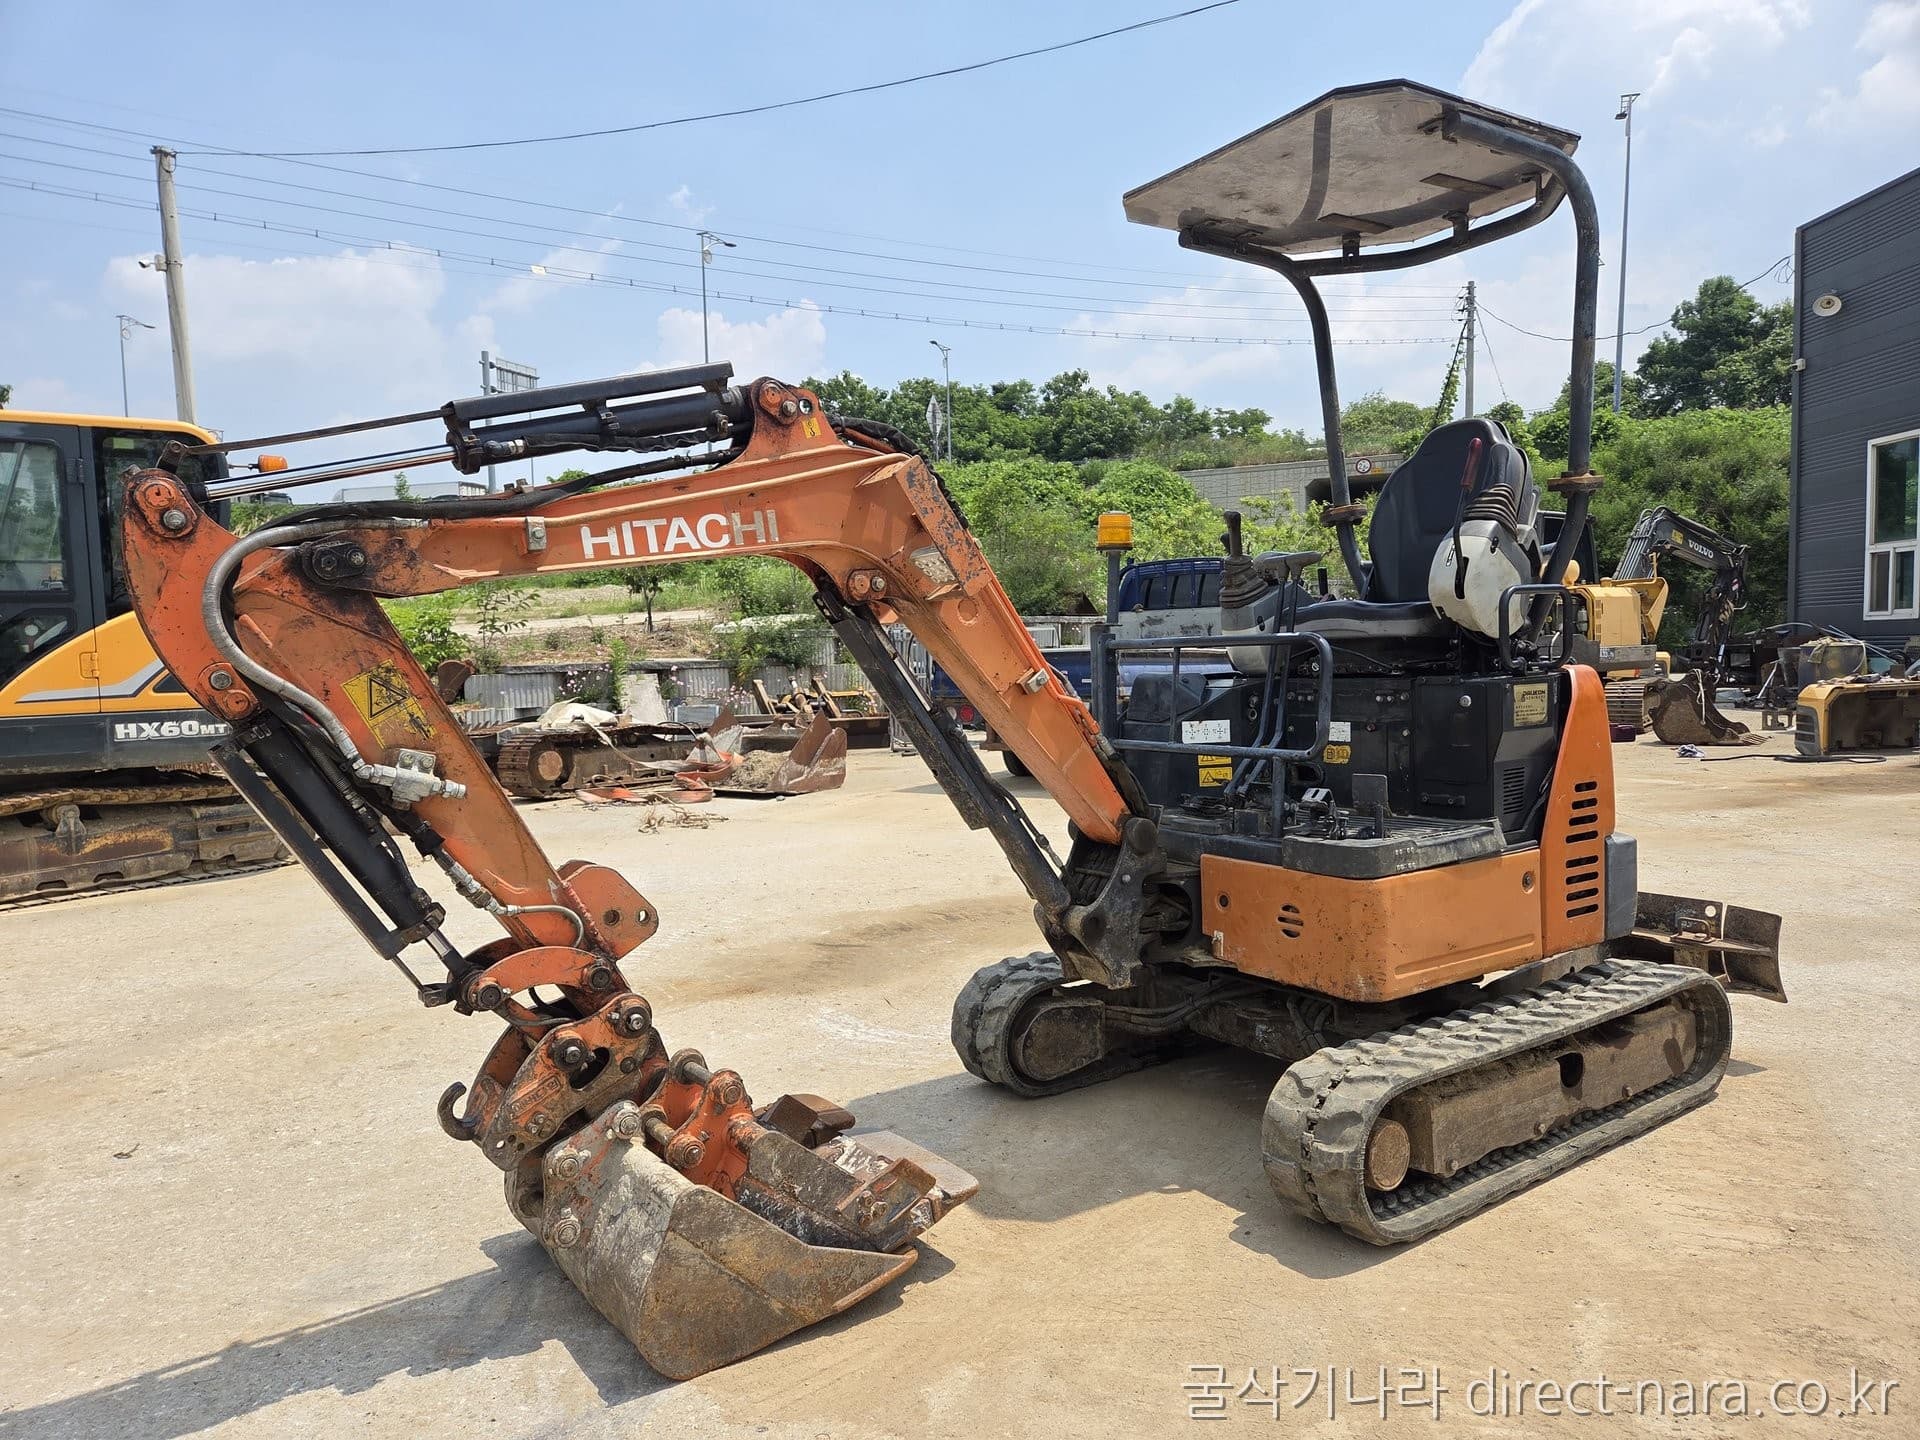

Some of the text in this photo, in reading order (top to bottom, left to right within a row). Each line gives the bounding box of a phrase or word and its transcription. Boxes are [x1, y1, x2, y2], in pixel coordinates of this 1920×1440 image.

[580, 509, 779, 559] HITACHI
[1688, 540, 1714, 559] VOLVO
[114, 720, 228, 739] HX60MT
